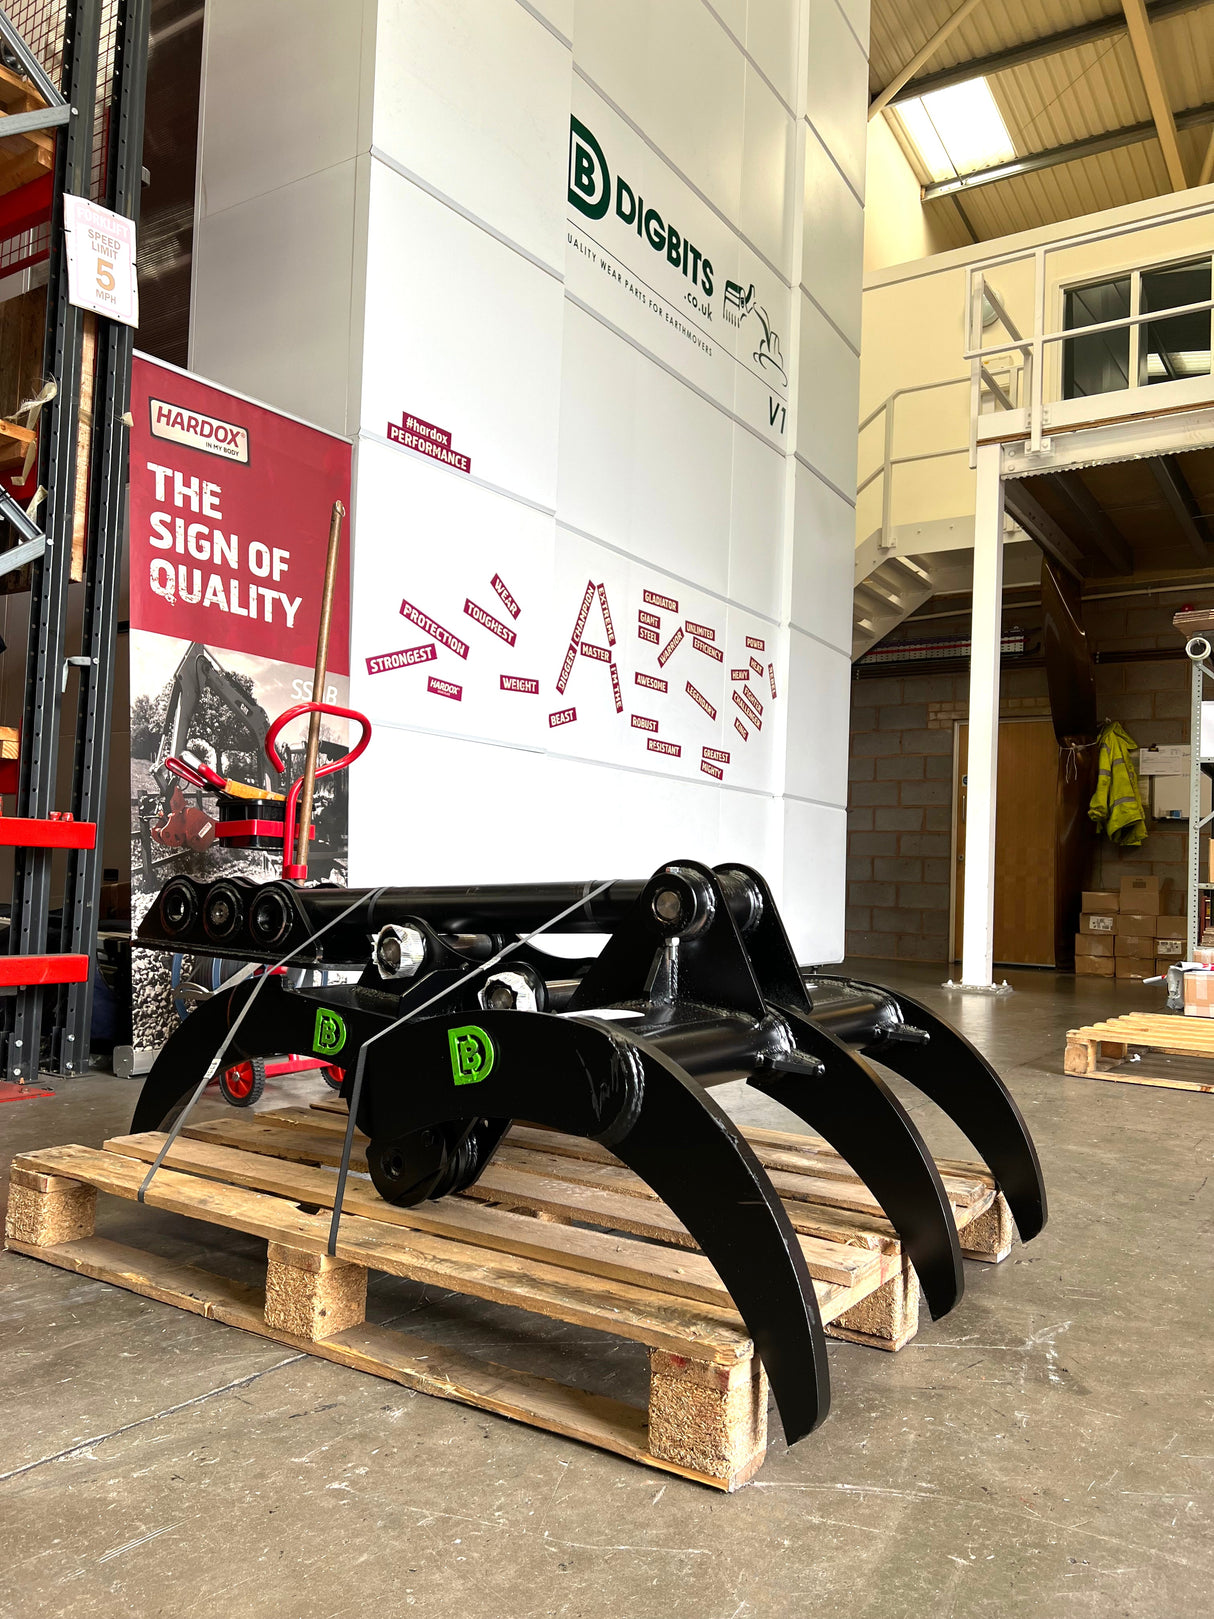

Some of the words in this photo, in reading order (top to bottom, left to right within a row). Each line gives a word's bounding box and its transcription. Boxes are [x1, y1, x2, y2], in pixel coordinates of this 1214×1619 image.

[79, 207, 130, 238] FORKLIFT
[616, 174, 714, 297] DIGBITS
[88, 228, 121, 251] SPEED
[91, 240, 118, 260] LIMIT
[95, 257, 116, 292] 5
[95, 288, 117, 305] MPH
[600, 258, 622, 283] WEAR
[624, 279, 646, 304] PARTS
[648, 299, 663, 317] FOR
[665, 312, 713, 358] EARTHMOVERS
[684, 292, 713, 323] .co.uk
[769, 396, 787, 435] V1
[406, 416, 448, 445] #hardox
[205, 441, 212, 449] IN
[213, 443, 222, 452] MY
[223, 447, 240, 457] BODY
[391, 426, 468, 470] PERFORMANCE
[147, 461, 223, 520] THE
[149, 511, 239, 570] SIGN
[248, 541, 290, 581] OF
[149, 558, 303, 629] QUALITY
[494, 578, 518, 616] WEAR
[644, 592, 677, 611] GLADIATOR
[466, 602, 515, 643] TOUGHEST
[572, 586, 595, 643] CHAMPION
[598, 586, 615, 644] EXTREME
[640, 612, 659, 627] GIANT
[402, 604, 465, 656] PROTECTION
[640, 628, 658, 643] STEEL
[686, 622, 714, 639] UNLIMITED
[582, 645, 610, 662] MASTER
[659, 631, 683, 664] WARRIOR
[694, 639, 722, 661] EFFICIENCY
[746, 638, 763, 650] POWER
[369, 646, 433, 673] STRONGEST
[557, 650, 576, 690] DIGGER
[502, 677, 537, 692] WEIGHT
[637, 674, 666, 692] AWESOME
[732, 670, 748, 680] HEAVY
[290, 679, 338, 706] SSB
[614, 685, 622, 708] THE
[687, 683, 716, 719] LEGENDARY
[550, 710, 575, 727] BEAST
[632, 716, 657, 731] ROBUST
[733, 693, 761, 728] CHALLENGER
[735, 719, 747, 739] KING
[648, 740, 680, 756] RESISTANT
[703, 748, 729, 762] GREATEST
[701, 762, 722, 779] MIGHTY
